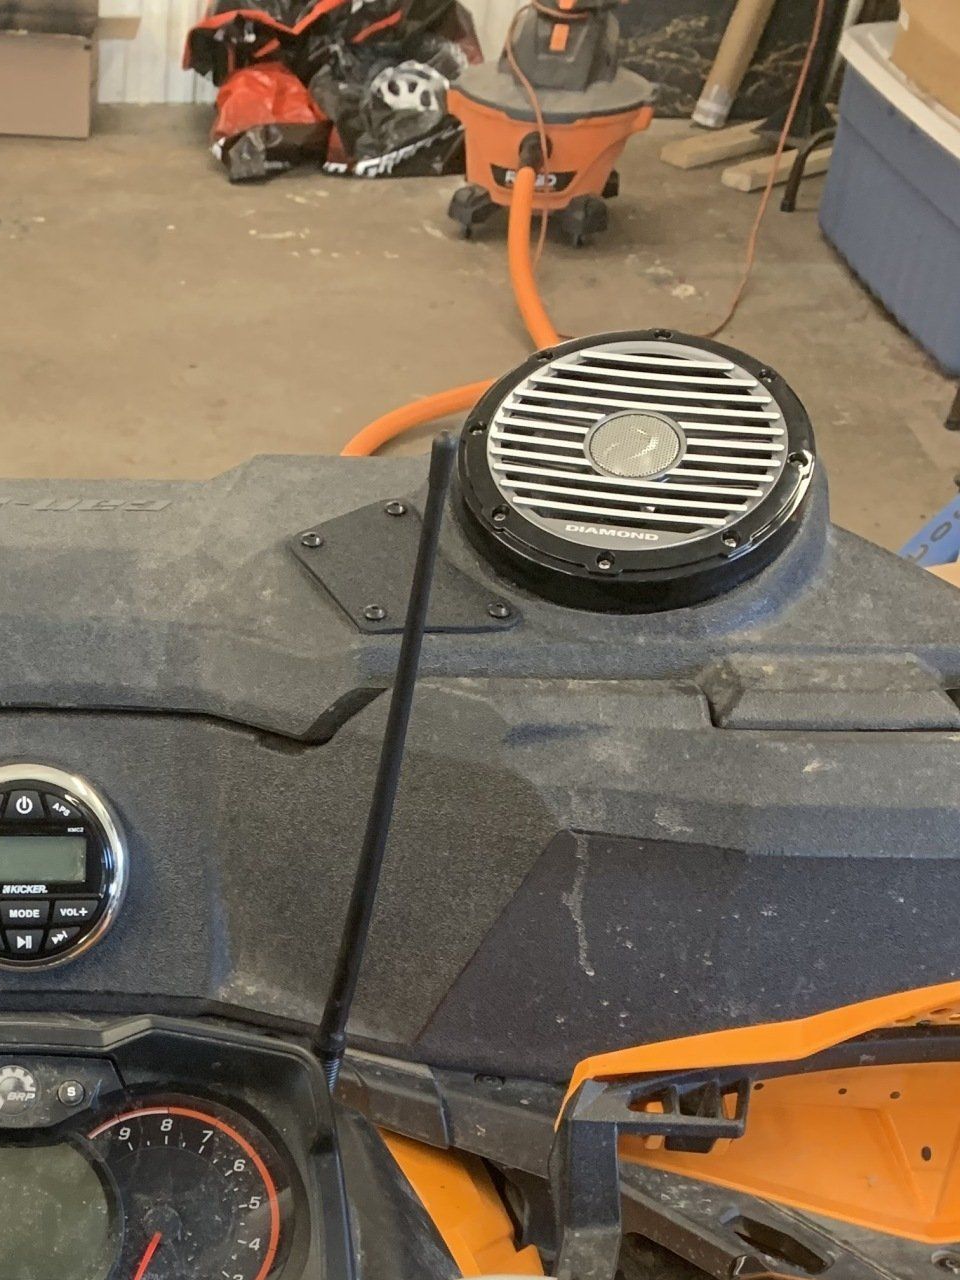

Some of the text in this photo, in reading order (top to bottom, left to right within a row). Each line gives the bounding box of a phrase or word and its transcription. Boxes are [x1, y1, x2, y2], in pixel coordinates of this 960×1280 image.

[565, 524, 660, 541] DIAMOND
[51, 802, 71, 817] APS
[8, 885, 46, 894] KICKER
[9, 909, 41, 918] MODE
[6, 1091, 37, 1102] BRP
[66, 1086, 77, 1097] S
[160, 1118, 173, 1132] 8
[118, 1126, 131, 1141] 9
[202, 1129, 214, 1143] 7
[233, 1158, 246, 1172] 6
[248, 1195, 262, 1209] 5
[248, 1237, 261, 1251] 4
